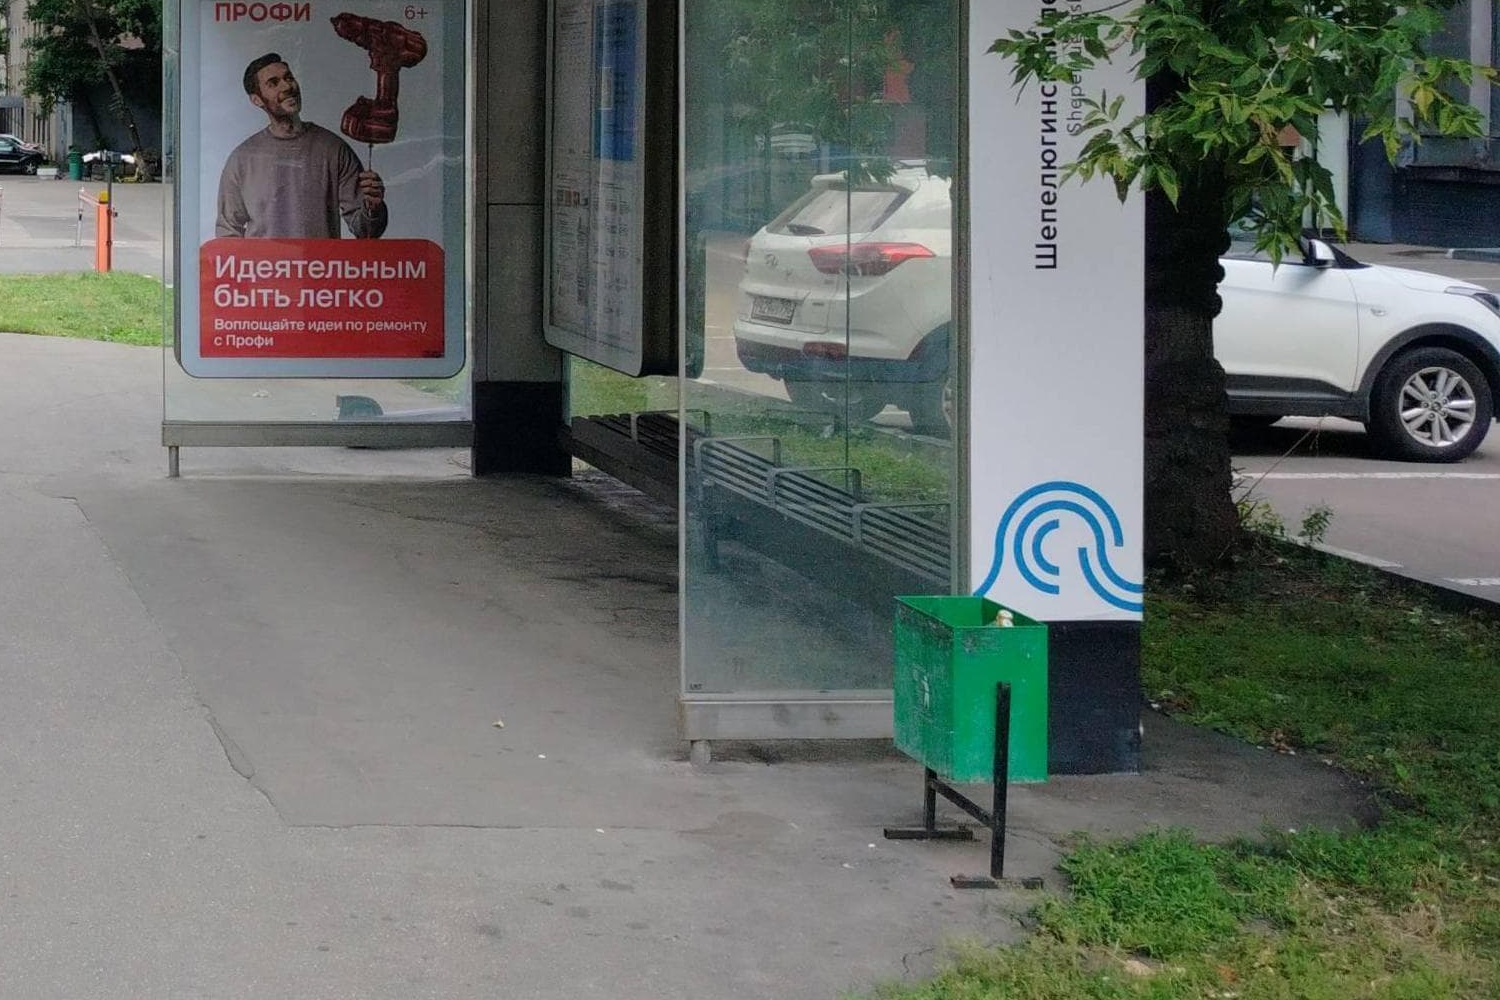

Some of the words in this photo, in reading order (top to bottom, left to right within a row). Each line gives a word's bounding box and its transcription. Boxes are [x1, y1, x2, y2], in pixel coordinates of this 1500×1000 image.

[215, 2, 310, 22] ПРОФИ
[404, 5, 429, 20] 6+
[1035, 29, 1058, 270] Шепелюгинс
[215, 255, 426, 283] Идеятельным
[214, 284, 291, 308] быть
[297, 288, 383, 308] легко
[214, 318, 305, 332] Воплощайте
[308, 320, 342, 332] идеи
[346, 320, 363, 331] по
[366, 320, 427, 334] ремонту
[214, 337, 222, 346] с
[226, 334, 274, 349] Профи
